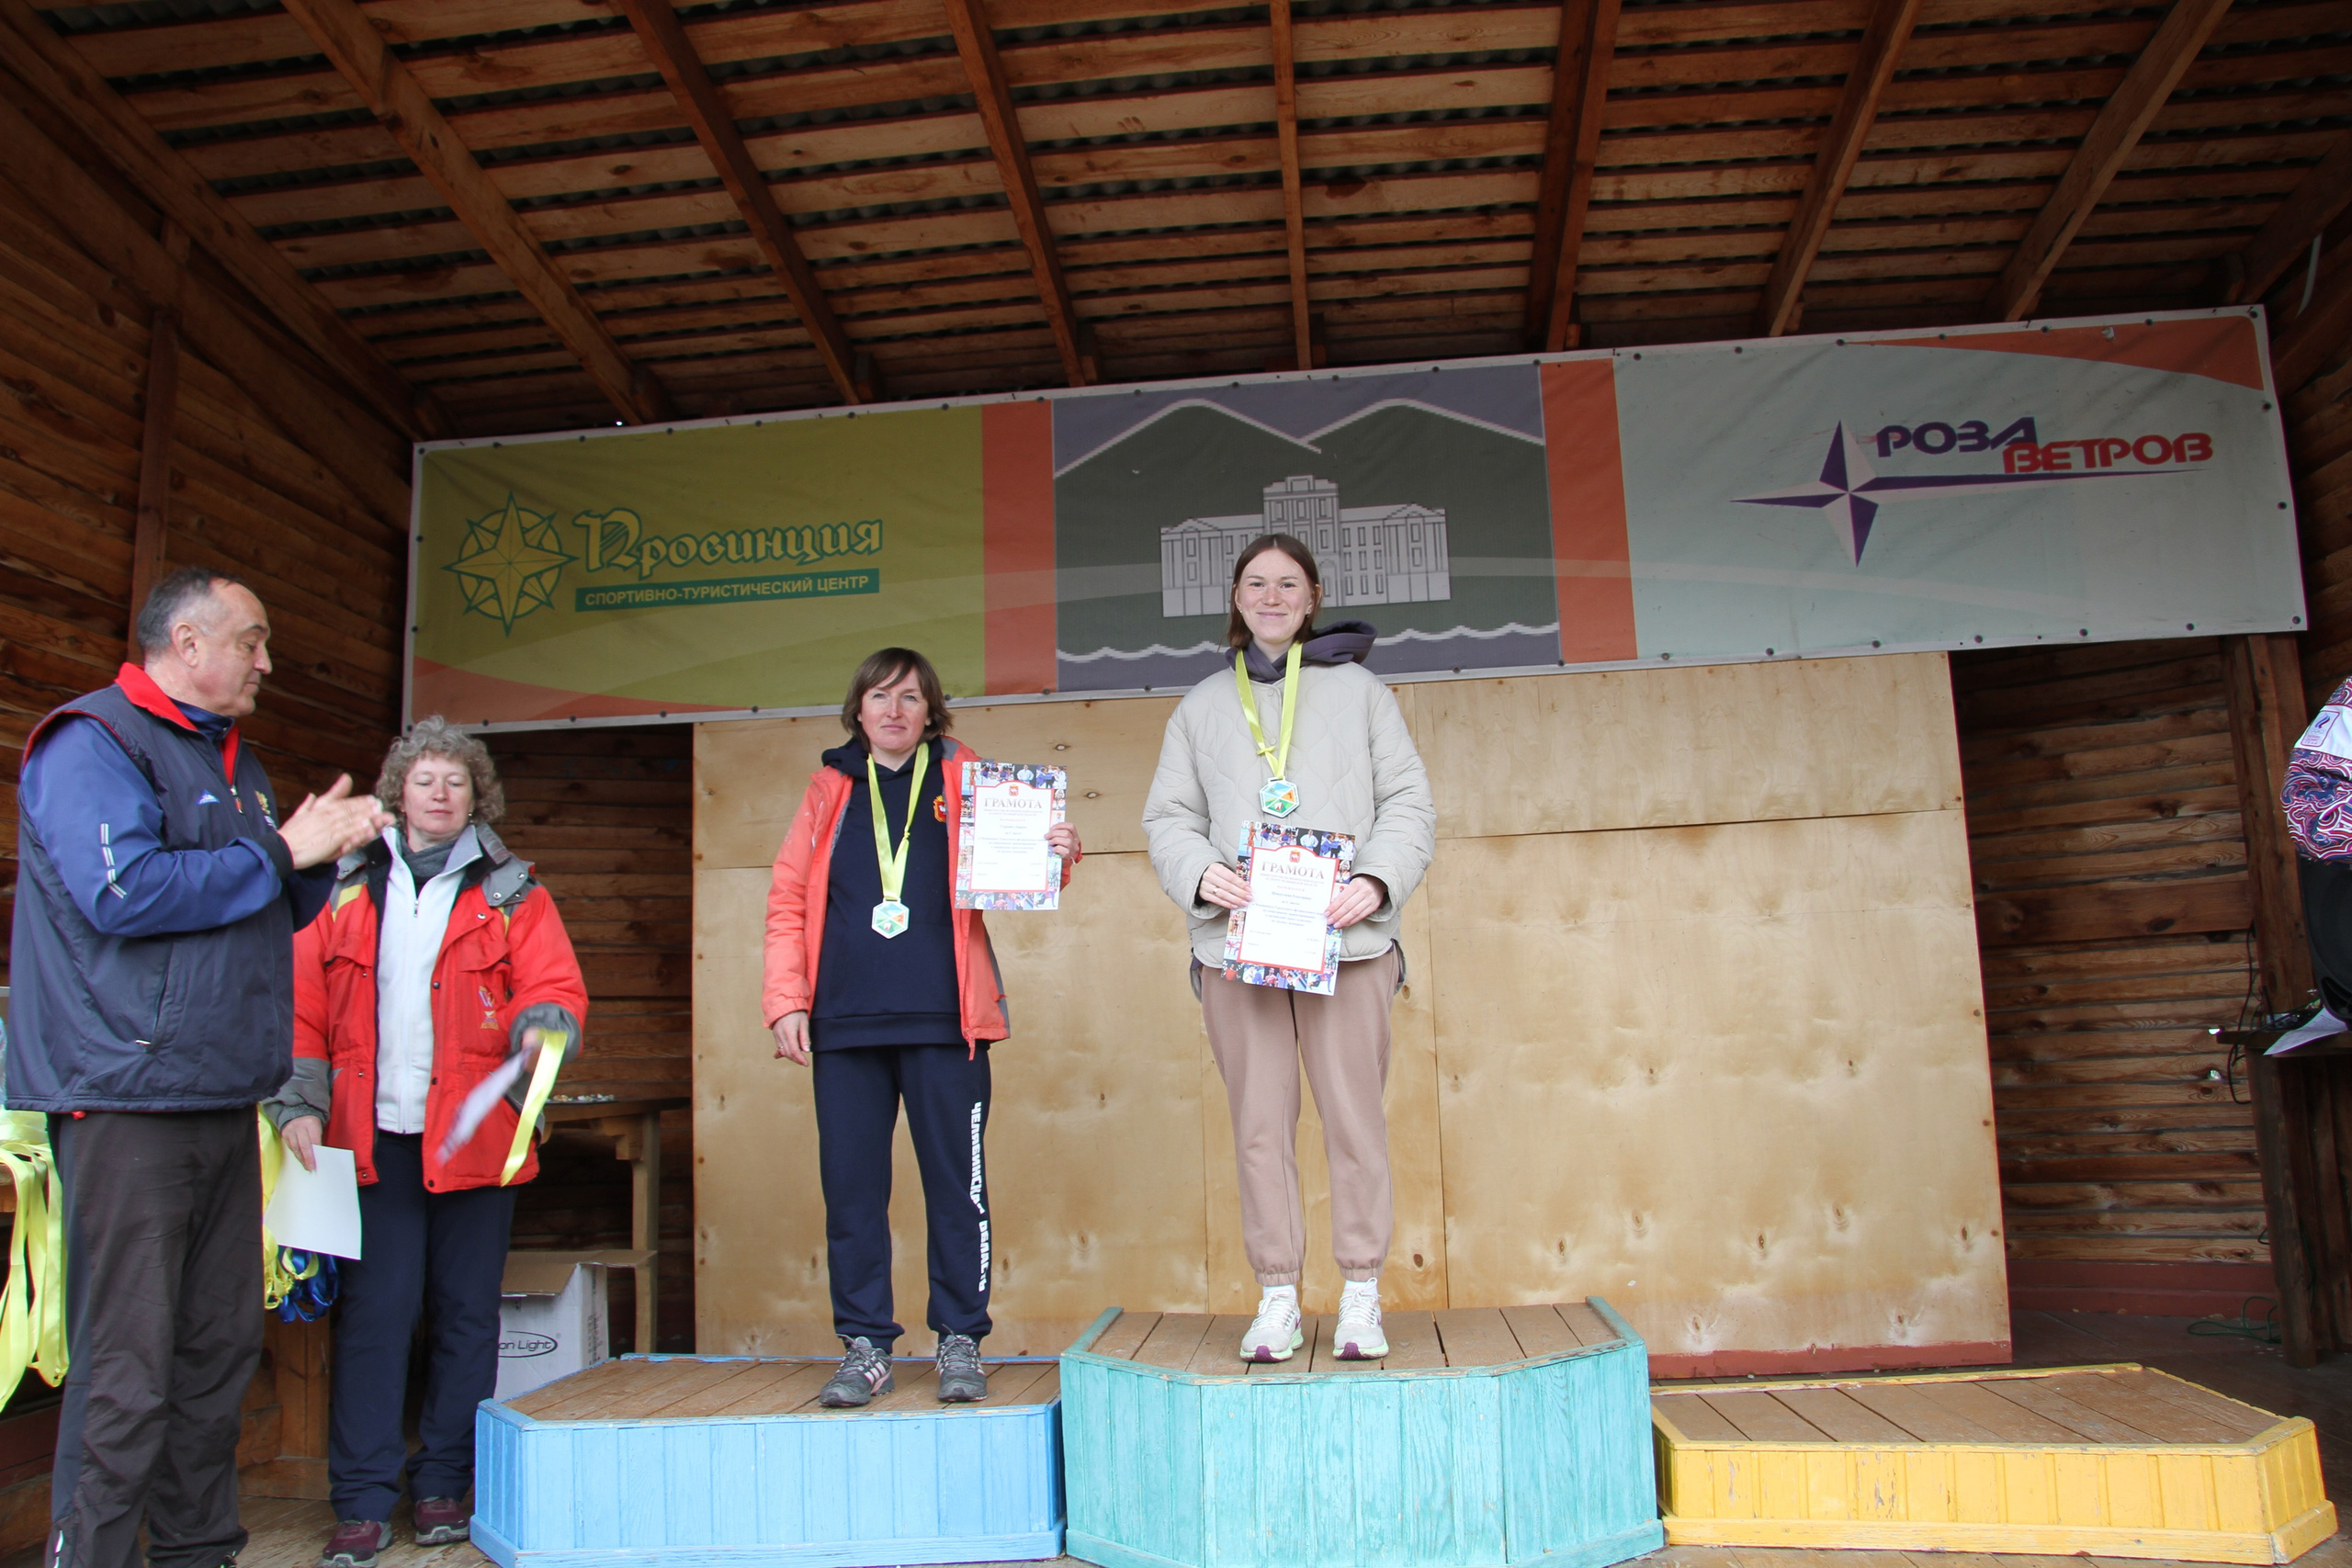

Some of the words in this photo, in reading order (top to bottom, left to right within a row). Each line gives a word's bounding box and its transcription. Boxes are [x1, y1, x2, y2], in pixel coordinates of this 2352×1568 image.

[1875, 416, 2037, 457] РОЗА
[2003, 432, 2214, 474] ВЕТРОВ
[571, 507, 883, 581] Провинция
[584, 576, 813, 606] СПОРТИВНО-ТУРИСТИЧЕСКИЙ
[817, 575, 869, 592] ЦЕНТР
[984, 797, 1043, 809] ГРАМОТА
[1262, 861, 1324, 879] ГРАМОТА
[517, 1339, 552, 1351] Light
